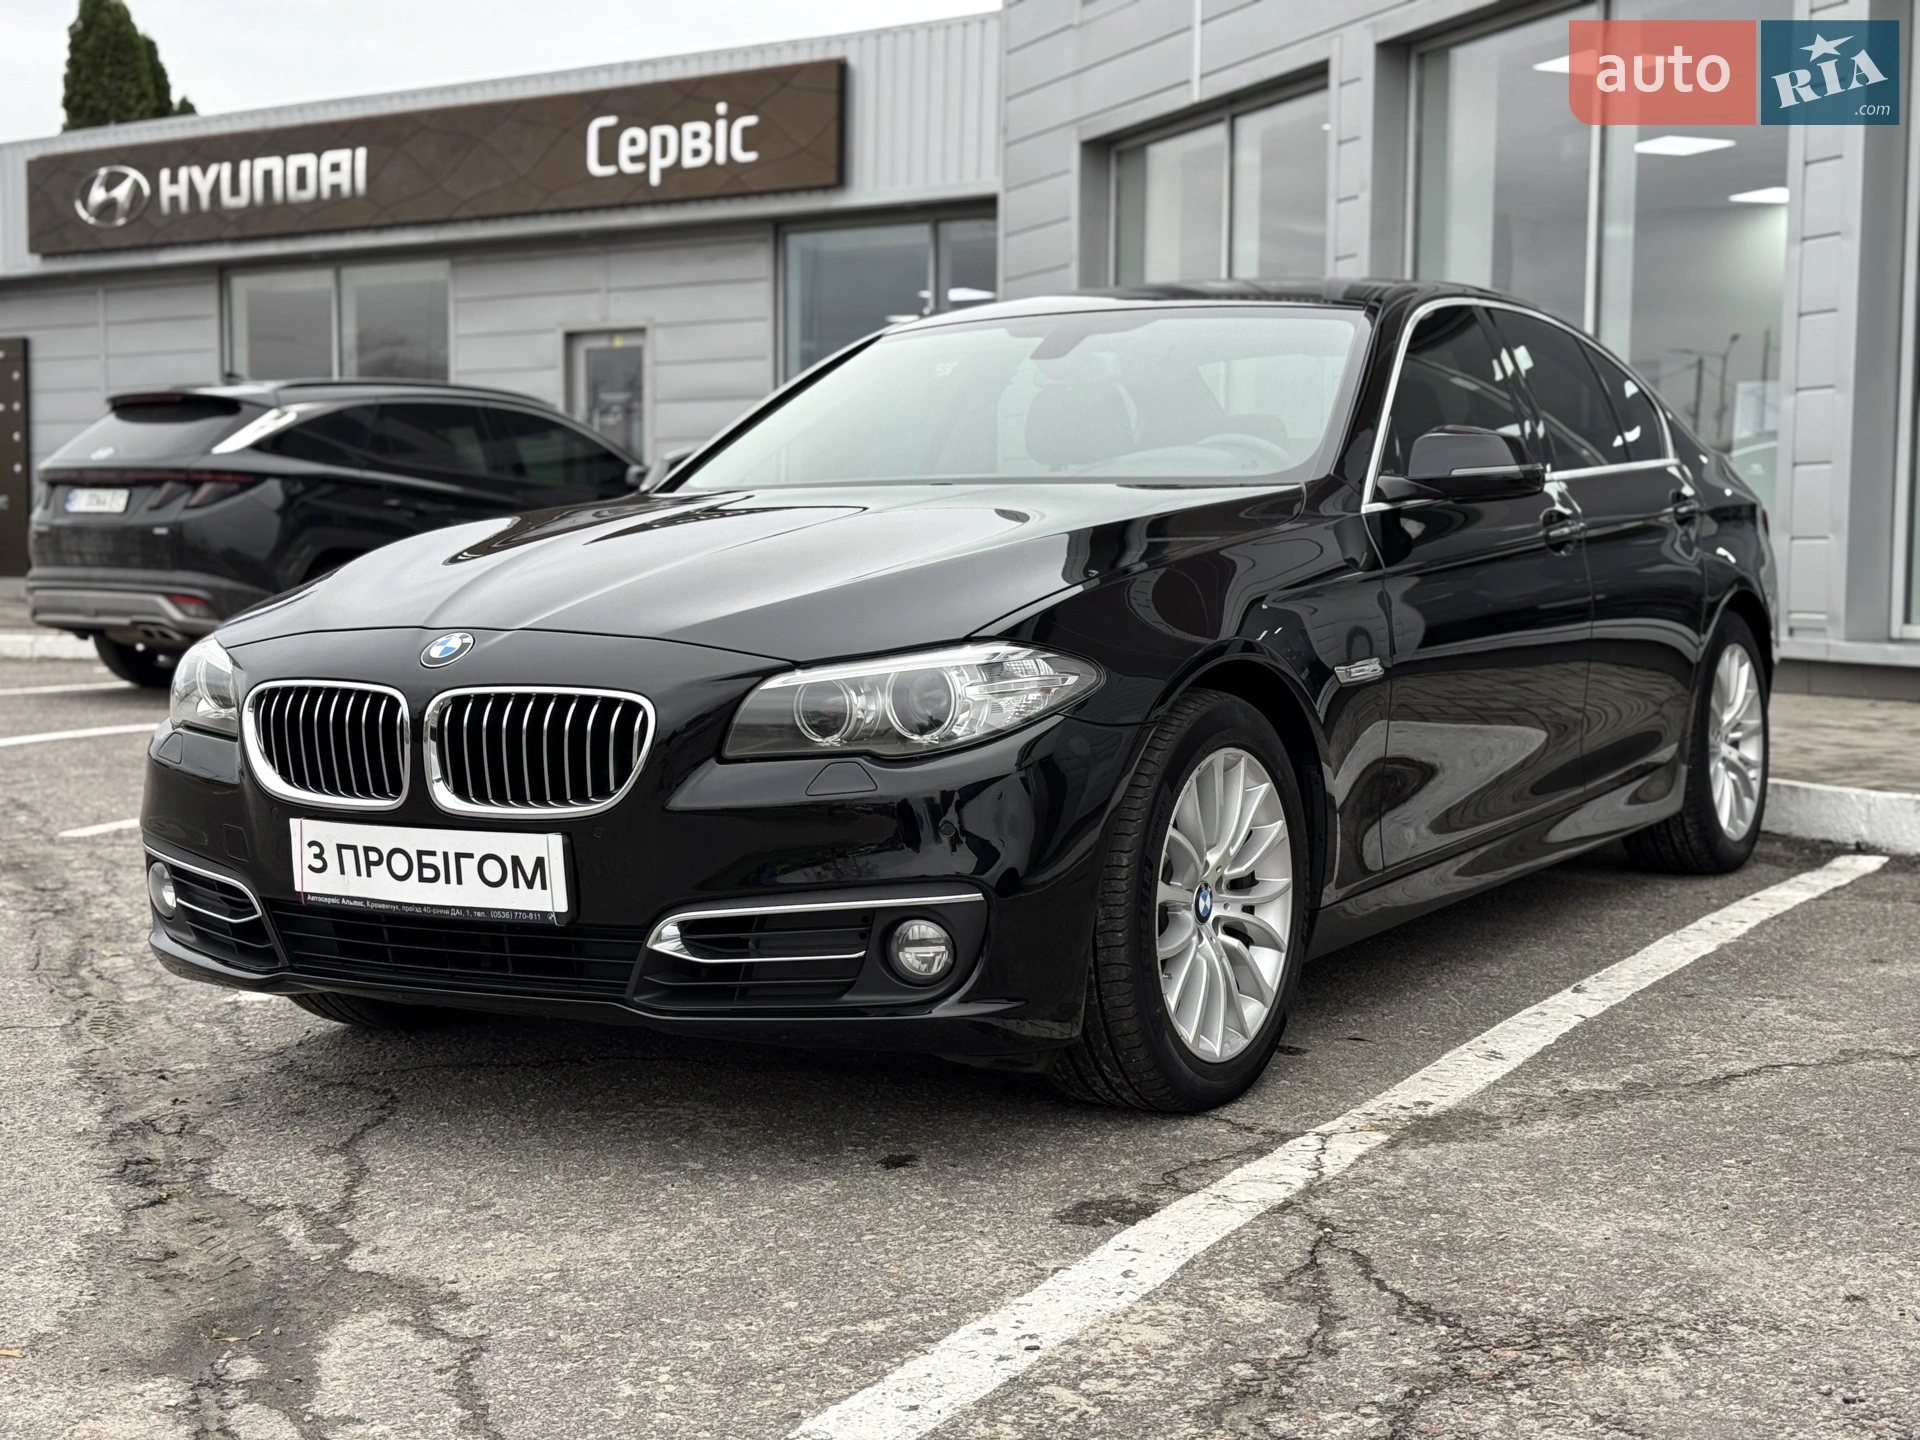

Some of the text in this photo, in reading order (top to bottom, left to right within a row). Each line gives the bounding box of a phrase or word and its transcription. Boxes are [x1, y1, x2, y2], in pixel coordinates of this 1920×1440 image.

[586, 101, 760, 187] Сервіс
[159, 146, 368, 216] HYUNDAI
[306, 839, 548, 891] З ПРОБІГОМ
[307, 894, 340, 905] Автосервіс
[366, 900, 401, 912] Кременчук,
[490, 909, 513, 920] (0536)
[514, 912, 541, 921] 770-811
